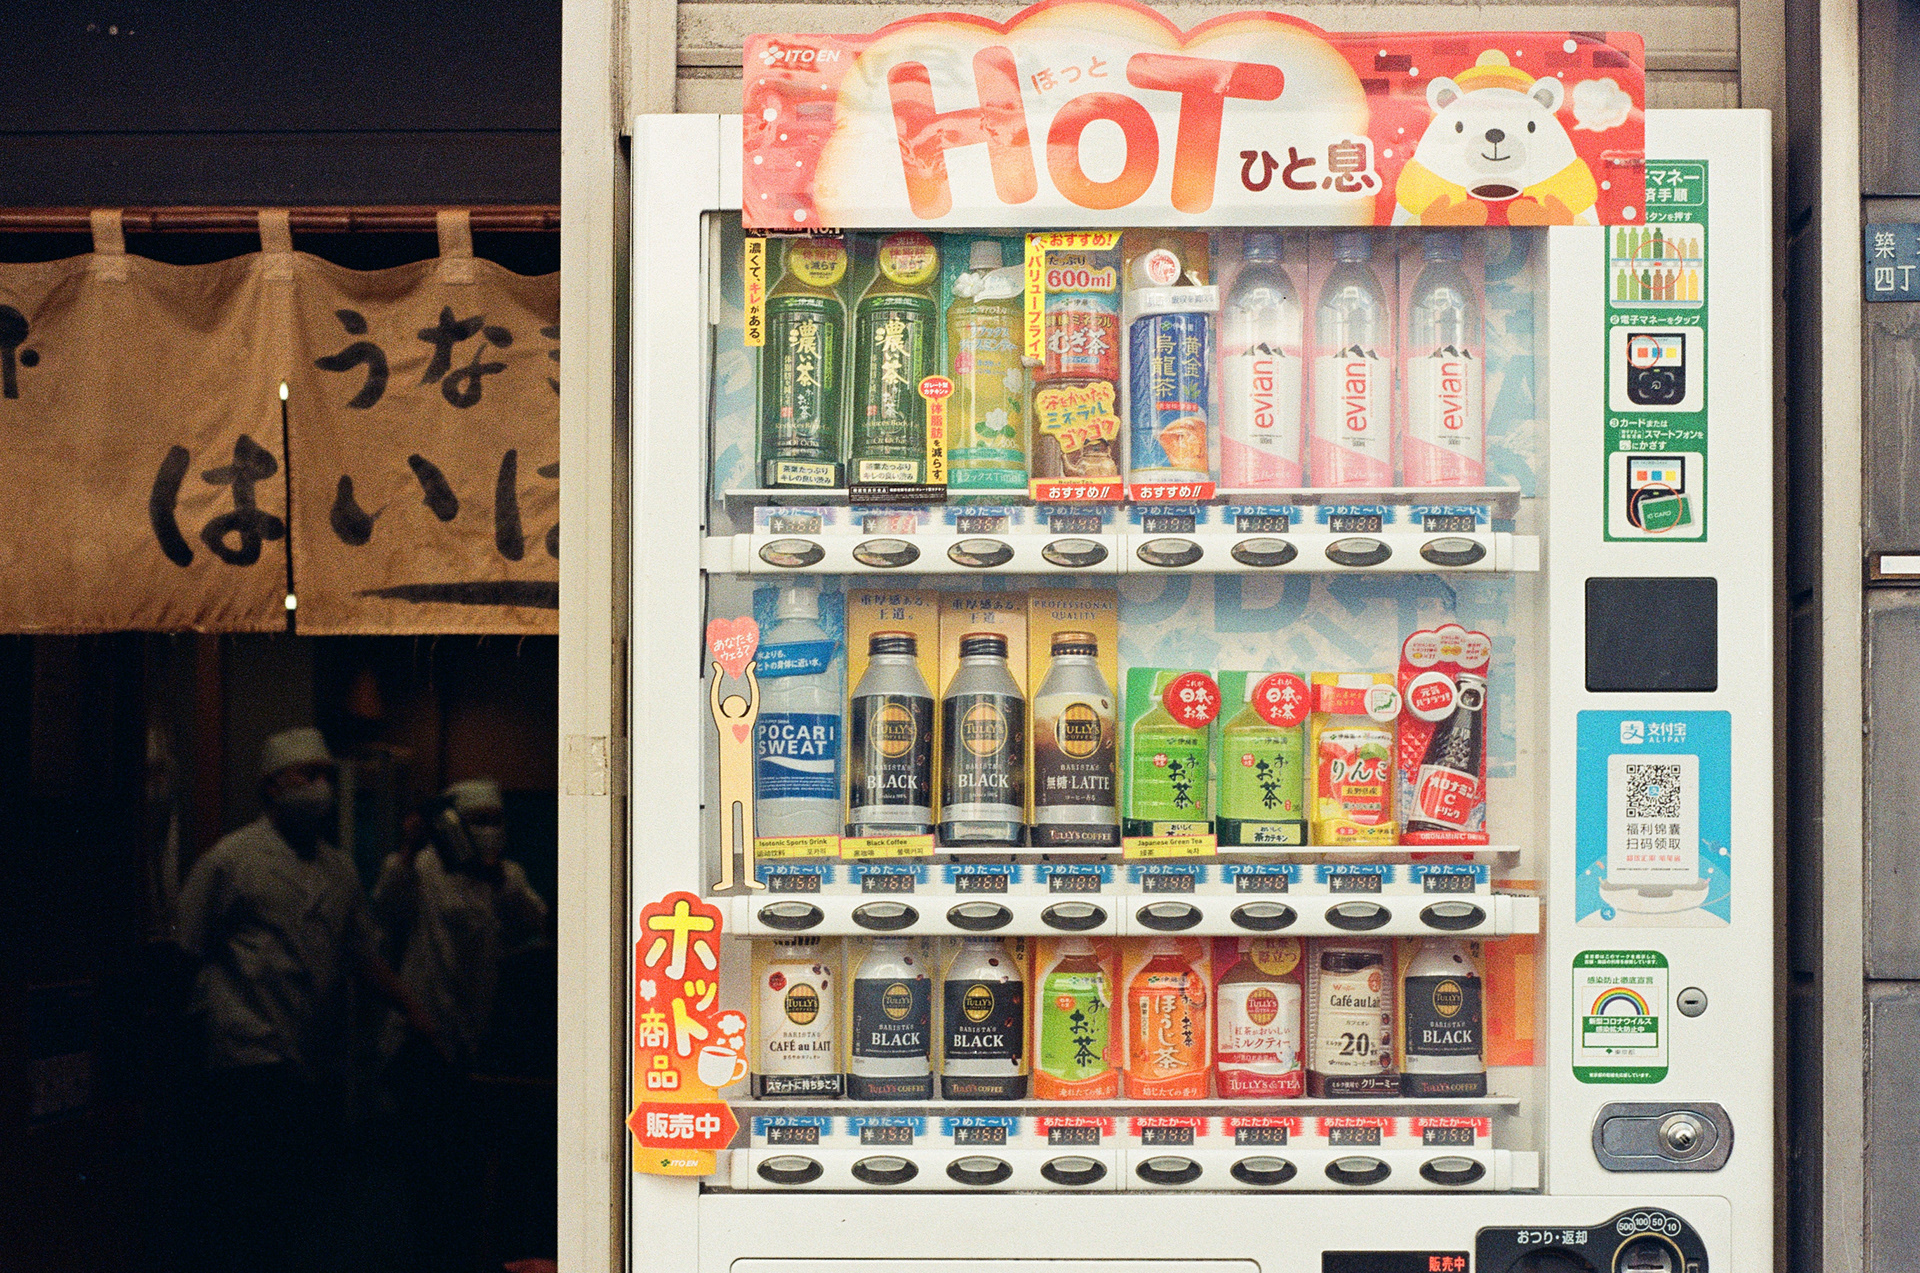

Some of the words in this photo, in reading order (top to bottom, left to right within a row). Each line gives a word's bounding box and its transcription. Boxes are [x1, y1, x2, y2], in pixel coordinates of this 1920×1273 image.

[785, 49, 815, 63] ITO
[816, 49, 840, 63] EN
[1031, 55, 1109, 94] ほっと
[1239, 138, 1373, 193] ひと息
[1050, 233, 1113, 247] おすすめ!
[1874, 231, 1920, 259] 築
[1049, 256, 1086, 267] たっぷり
[1048, 269, 1112, 288] 600ml
[748, 242, 763, 344] 濃くて、キレがある。
[1620, 314, 1700, 325] 電子マネーをタップ
[1047, 327, 1111, 356] むぎ茶
[314, 305, 560, 410] うな
[788, 319, 822, 387] 濃い茶
[875, 317, 911, 385] 濃い茶
[1181, 336, 1202, 378] 黄金
[1152, 335, 1176, 397] 烏龍茶
[1250, 358, 1274, 430] evian
[1341, 359, 1367, 432] evian
[1437, 360, 1463, 431] evian
[1047, 402, 1107, 429] ミネラル
[1060, 417, 1114, 449] ゴクゴク
[1645, 429, 1704, 440] スマートフォンを
[931, 403, 944, 482] 体脂肪を減らす。
[1632, 440, 1668, 451] にかざす
[860, 594, 930, 608] 重厚感ある、
[951, 598, 1021, 612] 重厚感ある、
[1034, 599, 1113, 611] PROFESSIONAL
[879, 607, 914, 622] 王道。
[1052, 610, 1097, 621] QUALITY
[713, 632, 755, 652] あなたも
[1184, 679, 1205, 687] これが
[1270, 677, 1292, 686] これが
[1178, 686, 1214, 704] 日本の
[1266, 686, 1303, 704] 日本の
[1420, 685, 1441, 697] 元気
[1183, 703, 1210, 720] お茶
[1270, 703, 1296, 720] お茶
[759, 725, 834, 741] POCARI
[1646, 722, 1687, 736] 支付宝
[759, 740, 828, 756] SWEAT
[867, 775, 919, 790] BLACK
[958, 775, 1010, 789] BLACK
[1167, 759, 1194, 810] お茶
[1255, 759, 1283, 810] お茶
[1444, 793, 1457, 805] C
[1081, 830, 1112, 841] COFFEE
[1254, 832, 1289, 842] 茶カテキン
[1626, 823, 1681, 837] 福利锦囊
[786, 839, 809, 847] Sports
[882, 838, 908, 846] Coffee
[1138, 839, 1168, 847] Japanese
[1626, 838, 1681, 851] 扫码领取
[1330, 994, 1352, 1008] Café
[1353, 997, 1366, 1008] au
[1069, 1008, 1101, 1068] お茶
[1152, 994, 1189, 1069] ほうじ茶
[1422, 1029, 1472, 1044] BLACK
[769, 1039, 797, 1052] CAFÉ
[797, 1043, 810, 1052] au
[812, 1041, 832, 1052] LAIT
[871, 1032, 921, 1047] BLACK
[953, 1034, 1005, 1048] BLACK
[1234, 1037, 1291, 1050] ミルクティー
[1339, 1032, 1370, 1057] 20
[639, 1007, 678, 1090] 商品
[767, 1079, 840, 1092] スマートに持ち歩こう
[897, 1083, 925, 1093] COFFEE
[977, 1084, 1004, 1094] COFFEE
[1279, 1079, 1301, 1091] TEA
[1360, 1078, 1399, 1089] クリーミー
[1450, 1082, 1477, 1092] COFFEE
[646, 1112, 722, 1140] 販売中
[1618, 1222, 1633, 1231] 500
[1635, 1217, 1648, 1227] 100
[1651, 1217, 1663, 1227] 50
[1666, 1222, 1677, 1232] 10
[1516, 1229, 1588, 1245] おつり・返却
